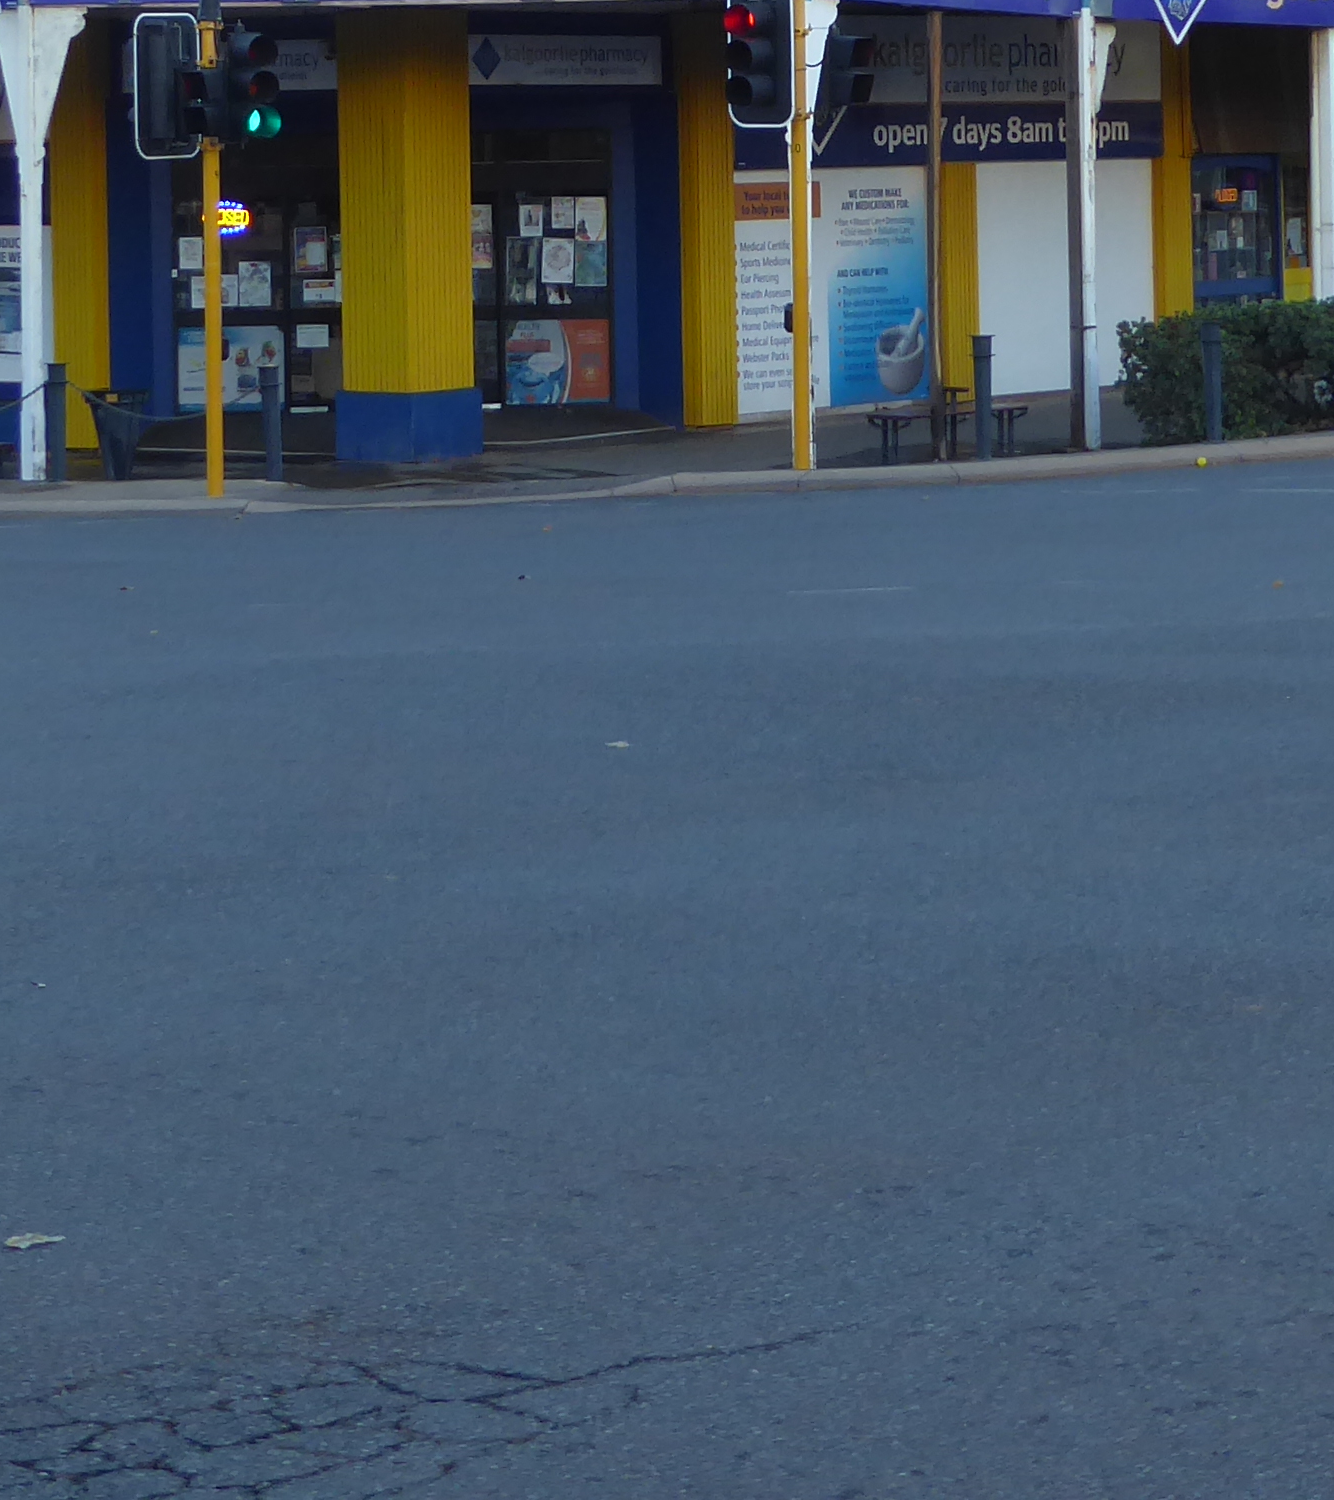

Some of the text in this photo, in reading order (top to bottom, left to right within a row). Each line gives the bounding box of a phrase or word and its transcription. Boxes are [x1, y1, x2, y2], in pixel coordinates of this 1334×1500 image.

[991, 77, 1011, 92] for
[1015, 78, 1038, 93] the
[873, 123, 928, 153] open
[952, 116, 1002, 151] days
[1007, 116, 1053, 144] 8am
